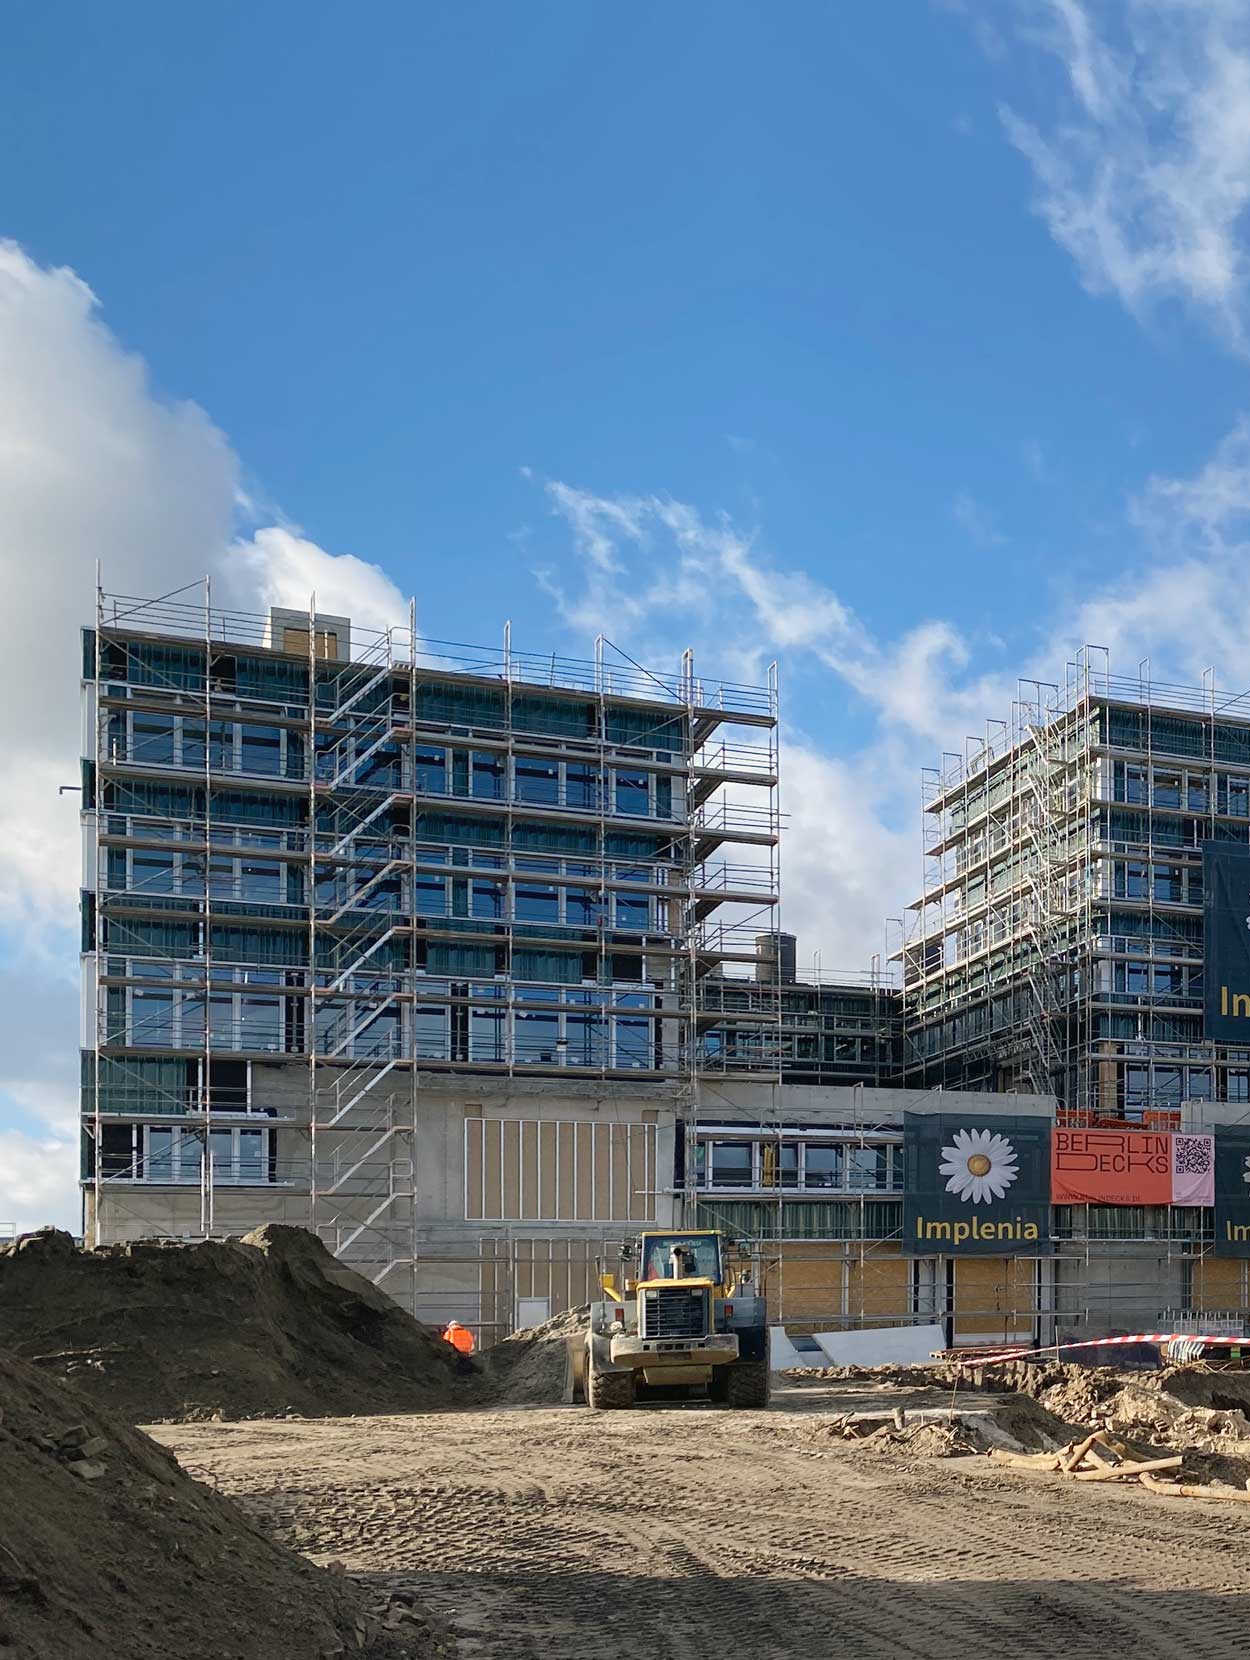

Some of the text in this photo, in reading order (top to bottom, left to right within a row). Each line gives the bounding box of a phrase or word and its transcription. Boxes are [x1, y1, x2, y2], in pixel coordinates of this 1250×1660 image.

[1055, 1132, 1169, 1155] BERLIN
[1055, 1152, 1169, 1174] DECKS
[916, 1215, 1039, 1246] Implenia
